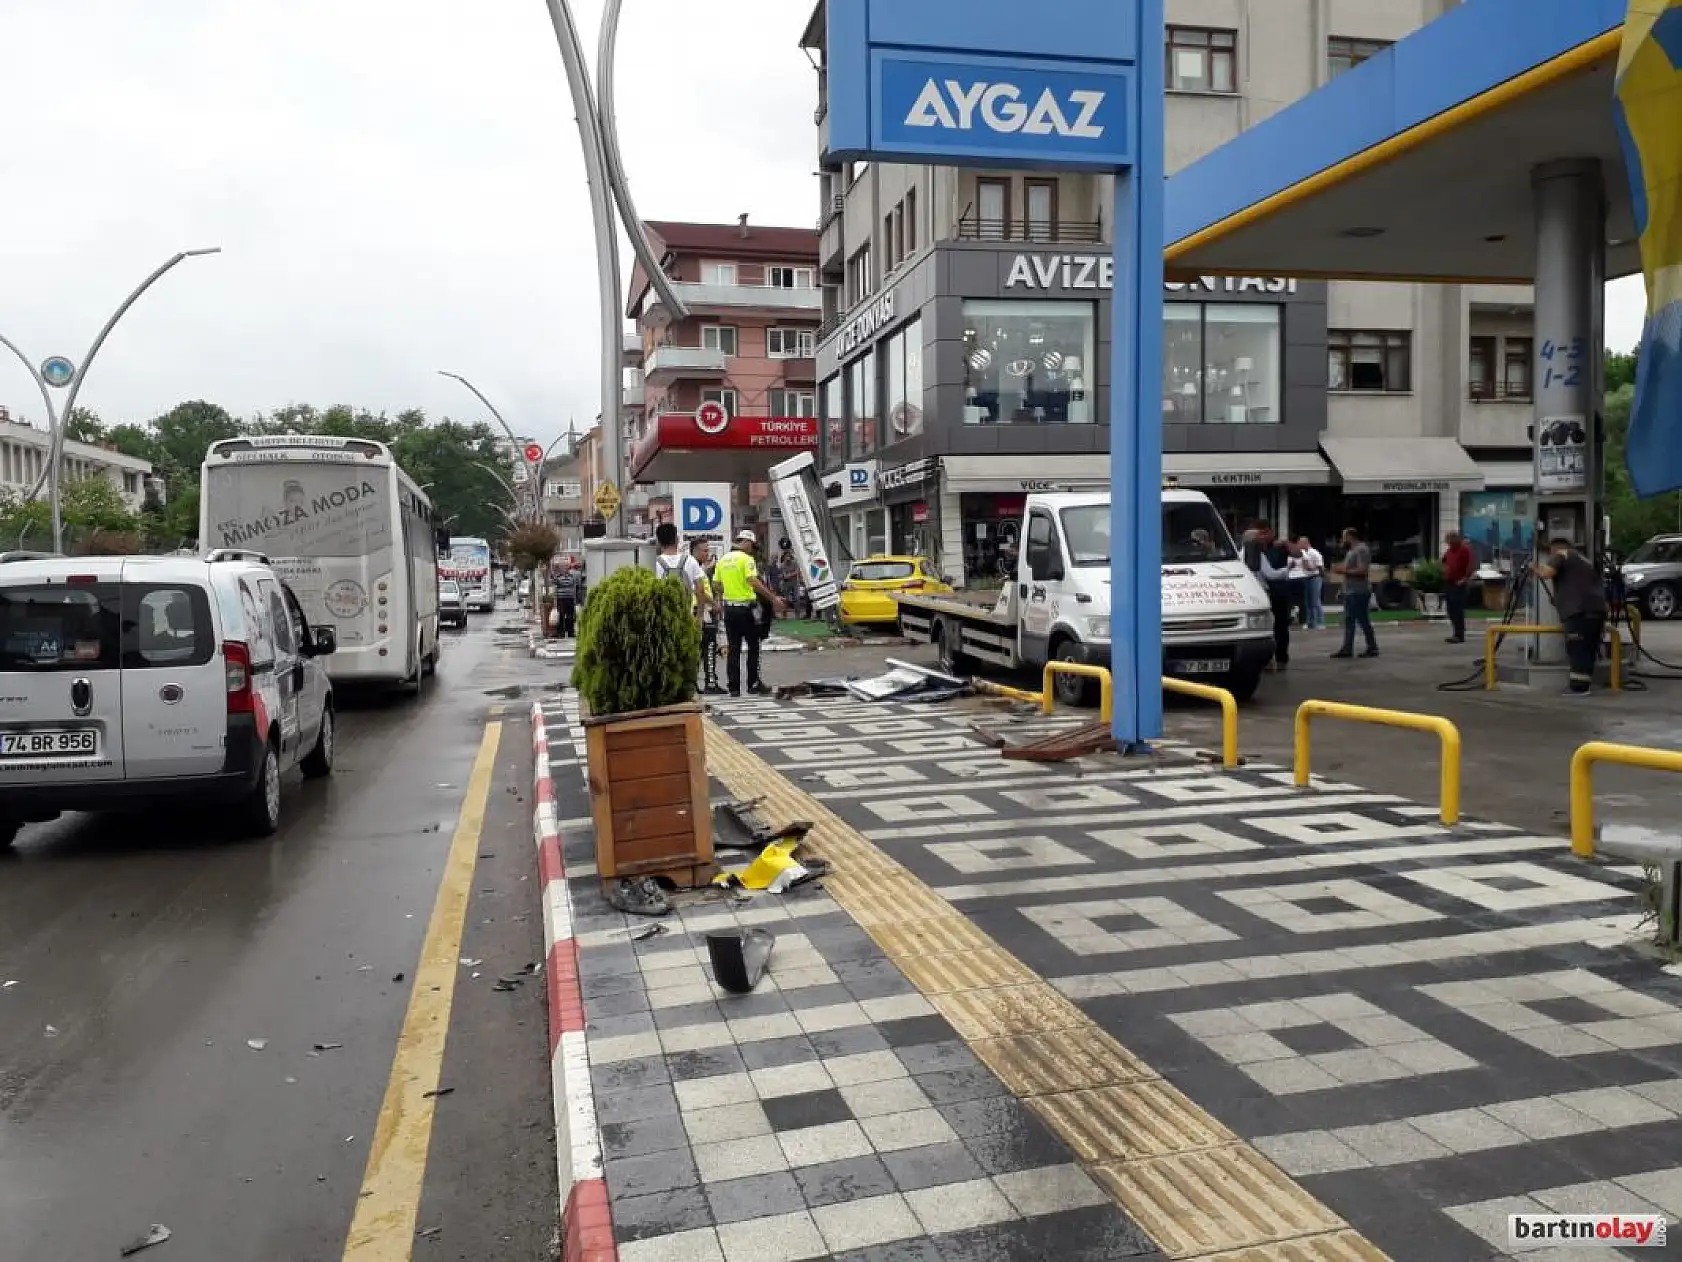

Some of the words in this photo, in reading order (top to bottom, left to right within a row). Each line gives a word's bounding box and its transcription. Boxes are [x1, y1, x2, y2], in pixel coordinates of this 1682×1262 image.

[904, 76, 1106, 138] AYGAZ
[760, 421, 808, 432] TÜRKİYE
[312, 480, 376, 515] MODA
[682, 498, 722, 530] DD
[5, 735, 28, 752] 74
[31, 735, 53, 750] BR
[58, 734, 92, 749] 956
